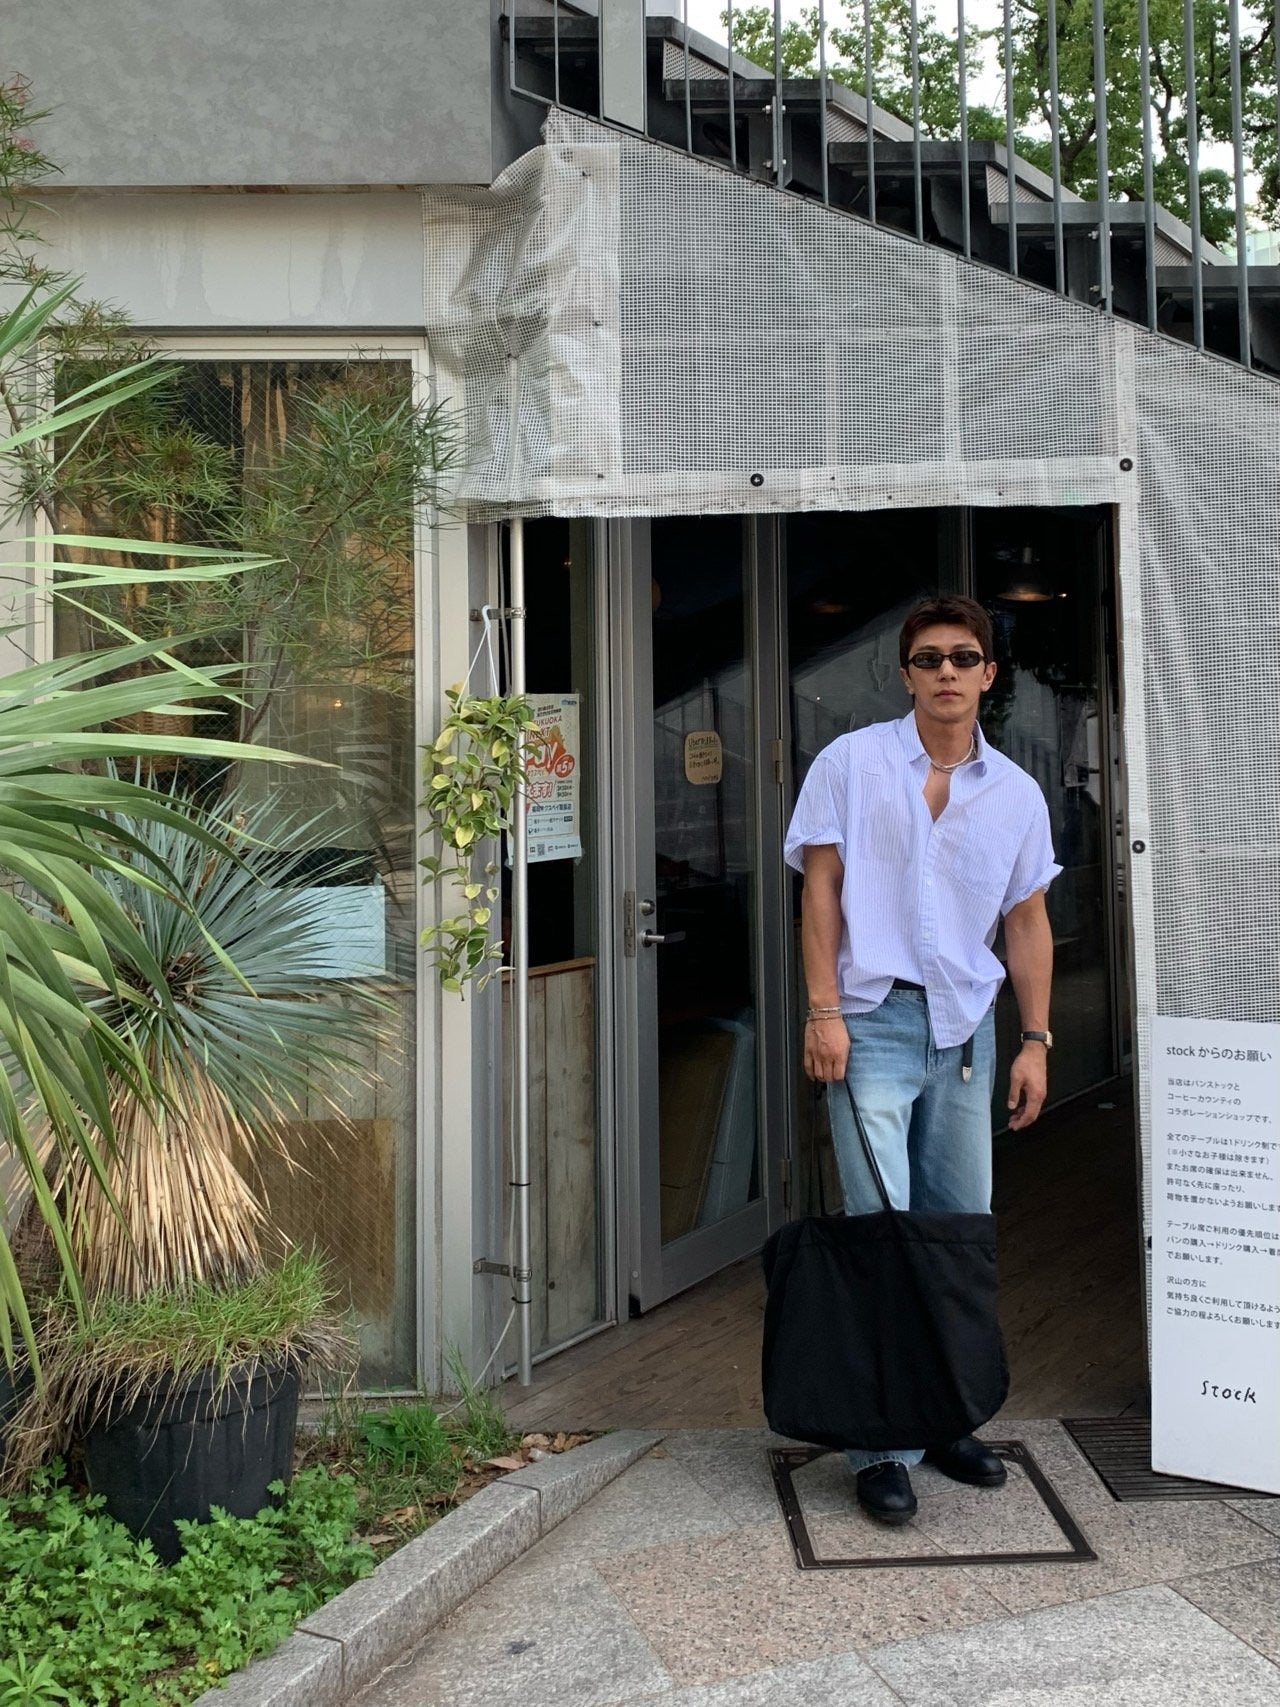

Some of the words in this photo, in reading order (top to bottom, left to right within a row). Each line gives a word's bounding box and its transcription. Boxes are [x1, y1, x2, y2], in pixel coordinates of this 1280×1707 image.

[1166, 1046, 1196, 1057] stock
[1199, 1046, 1272, 1062] からのお願い
[1167, 1132, 1280, 1151] 全てのテーブルは1ドリンク制で
